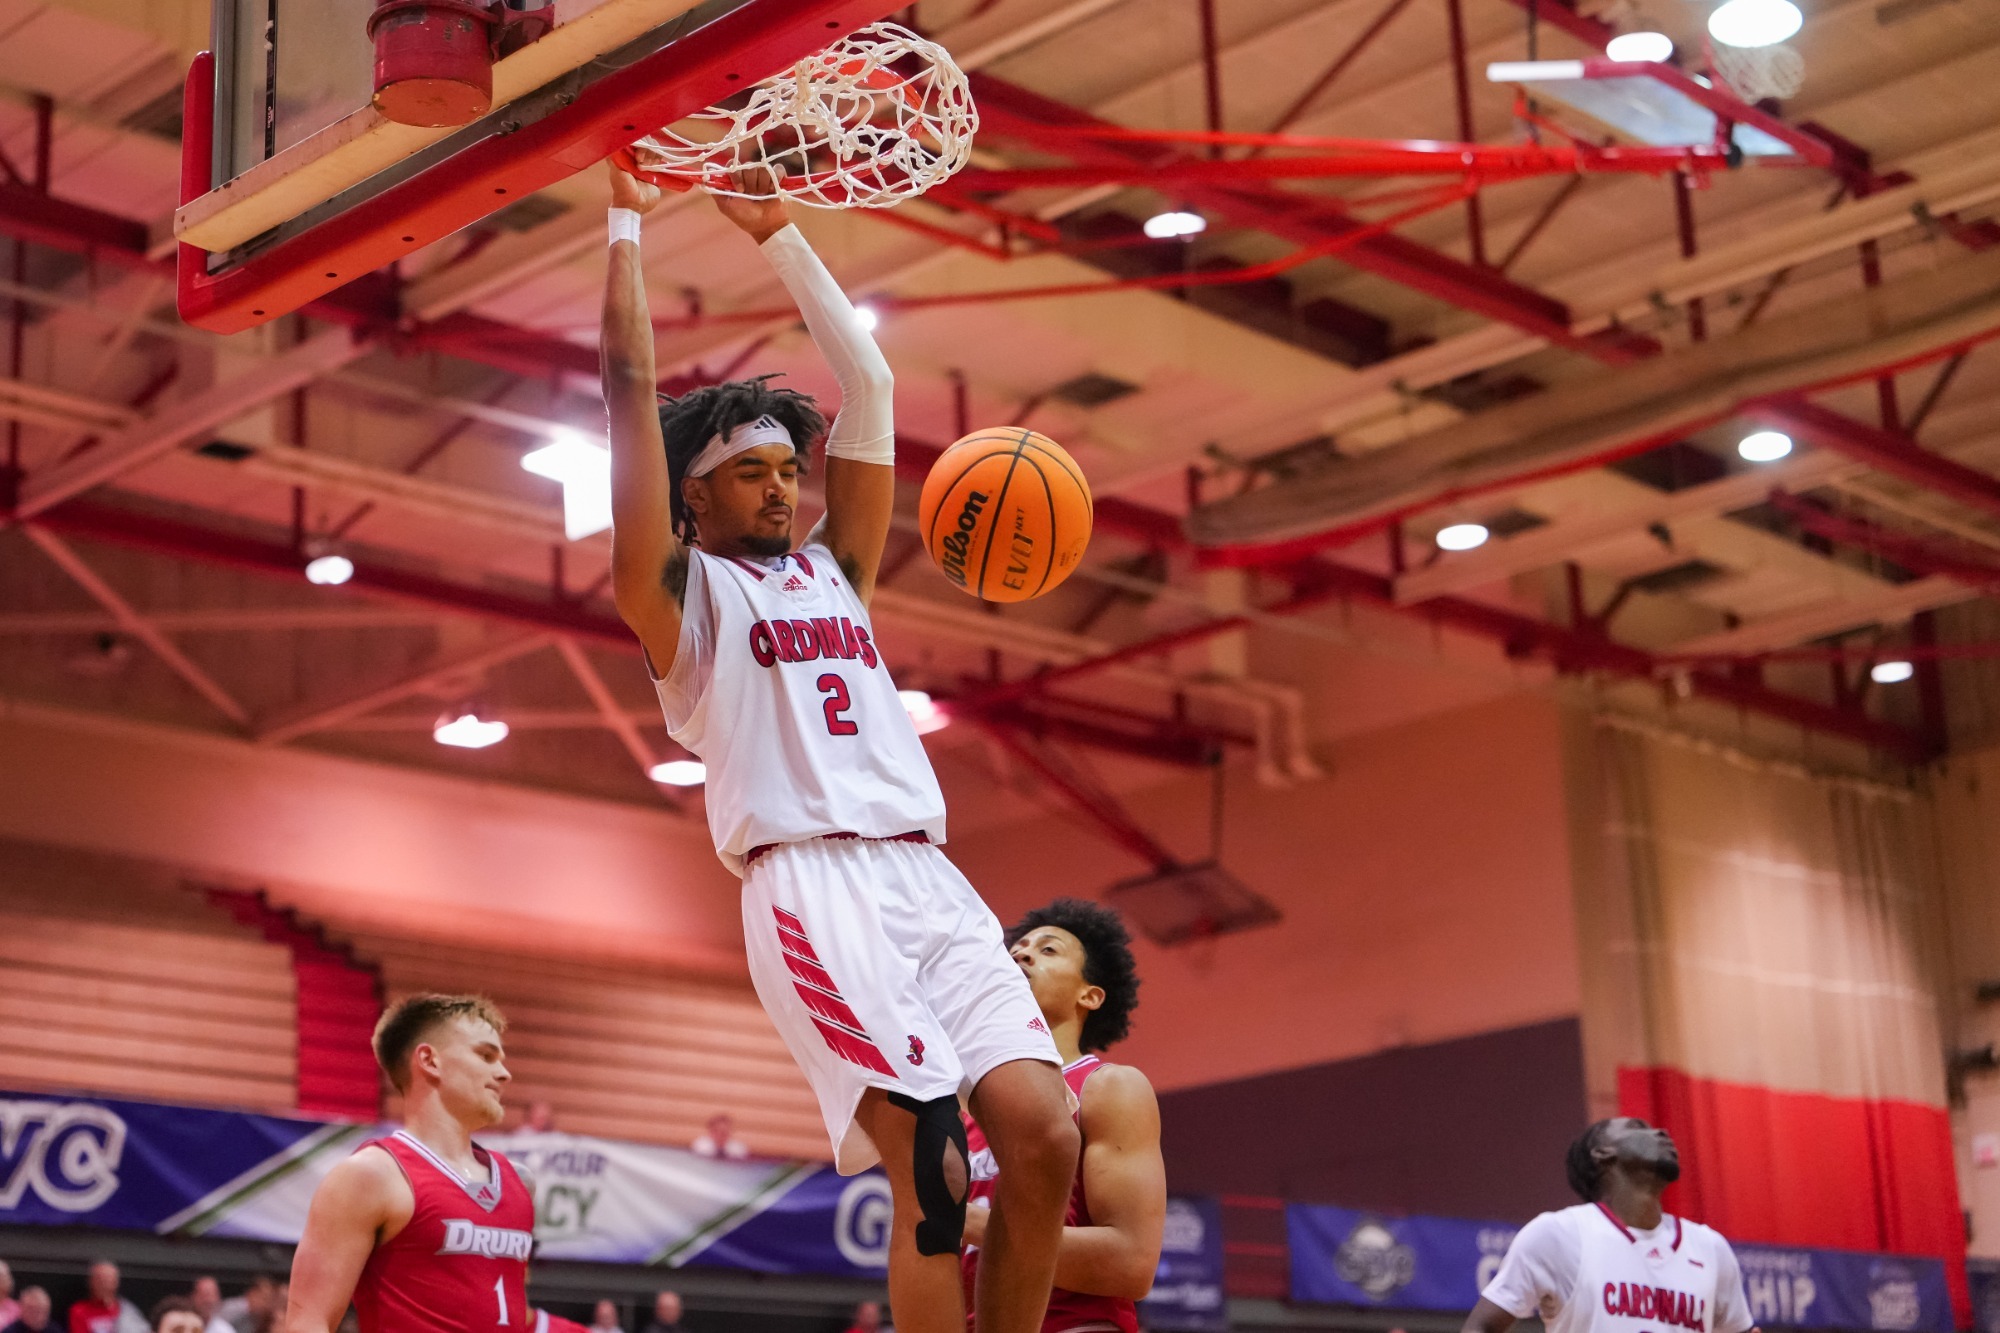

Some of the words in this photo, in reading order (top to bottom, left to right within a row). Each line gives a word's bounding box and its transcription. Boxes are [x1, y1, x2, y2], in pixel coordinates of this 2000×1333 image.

[942, 490, 989, 587] Wilson
[749, 616, 878, 670] CARDINAS
[816, 673, 859, 736] 2
[494, 1275, 510, 1326] 1
